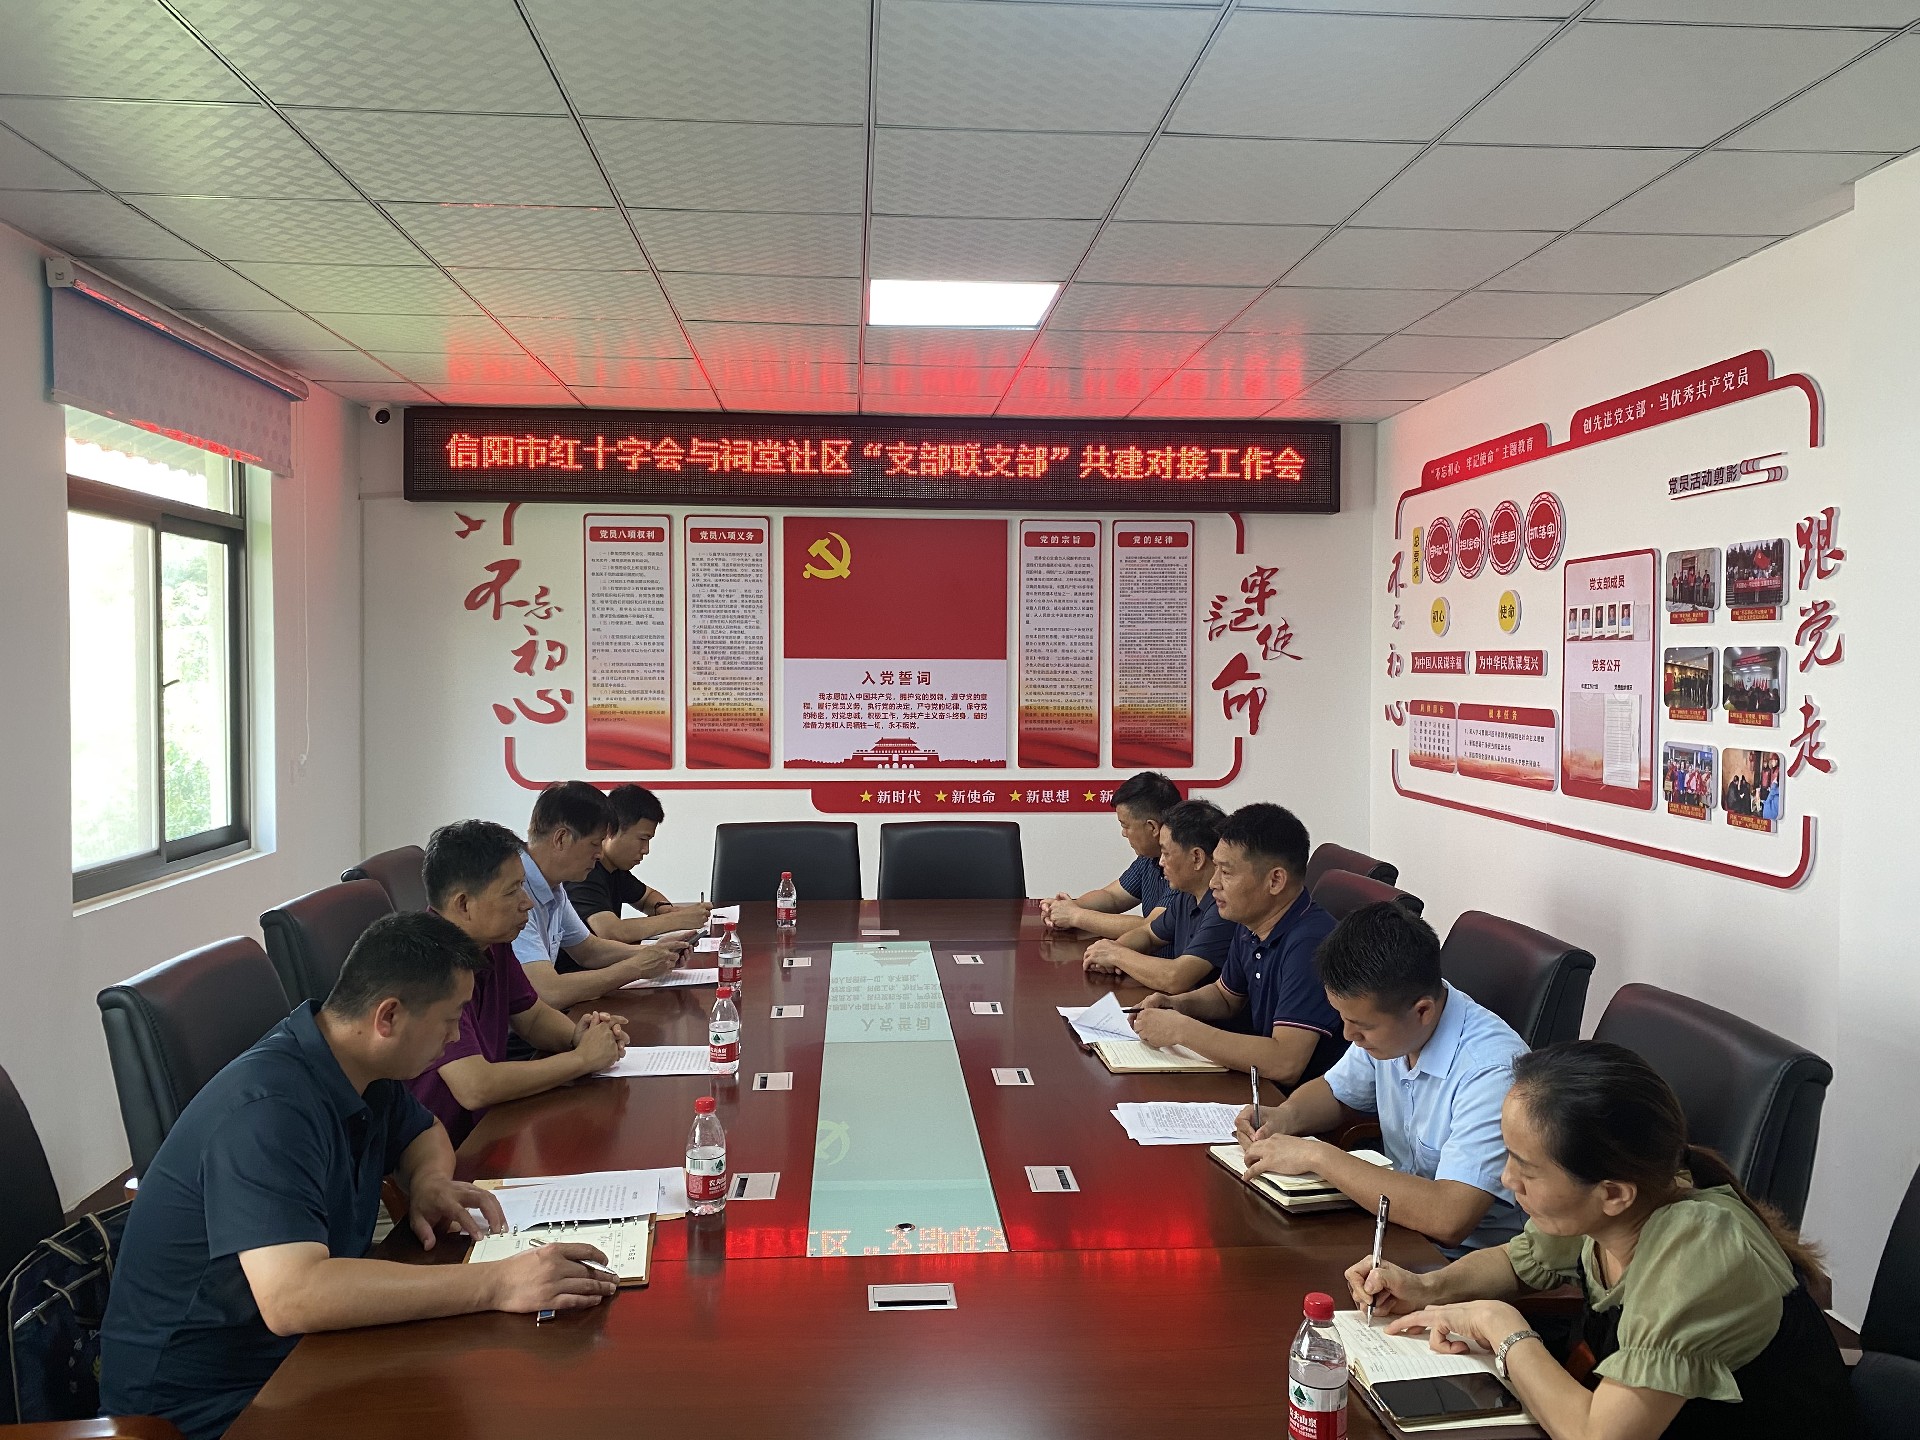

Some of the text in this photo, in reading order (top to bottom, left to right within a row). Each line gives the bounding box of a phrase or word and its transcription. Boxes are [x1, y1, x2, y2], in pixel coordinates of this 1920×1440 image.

[1668, 463, 1738, 495] 党员活动剪影
[599, 529, 655, 539] 党员八项权利
[700, 530, 755, 541] 党员八项义务
[1039, 535, 1081, 544] 党的宗旨
[1132, 535, 1173, 545] 党的纪律
[1589, 574, 1625, 591] 党支部成员
[1432, 610, 1445, 623] 初心
[1500, 605, 1515, 619] 使命
[1787, 507, 1845, 777] 跟党走
[1414, 656, 1462, 670] 为中国人民谋幸福
[1479, 655, 1539, 671] 为中华民族谋复兴
[1591, 659, 1621, 673] 党务公开
[861, 670, 931, 686] 入党誓词
[877, 790, 921, 804] 新时代
[951, 790, 996, 804] 新使命
[1026, 790, 1070, 804] 新思想
